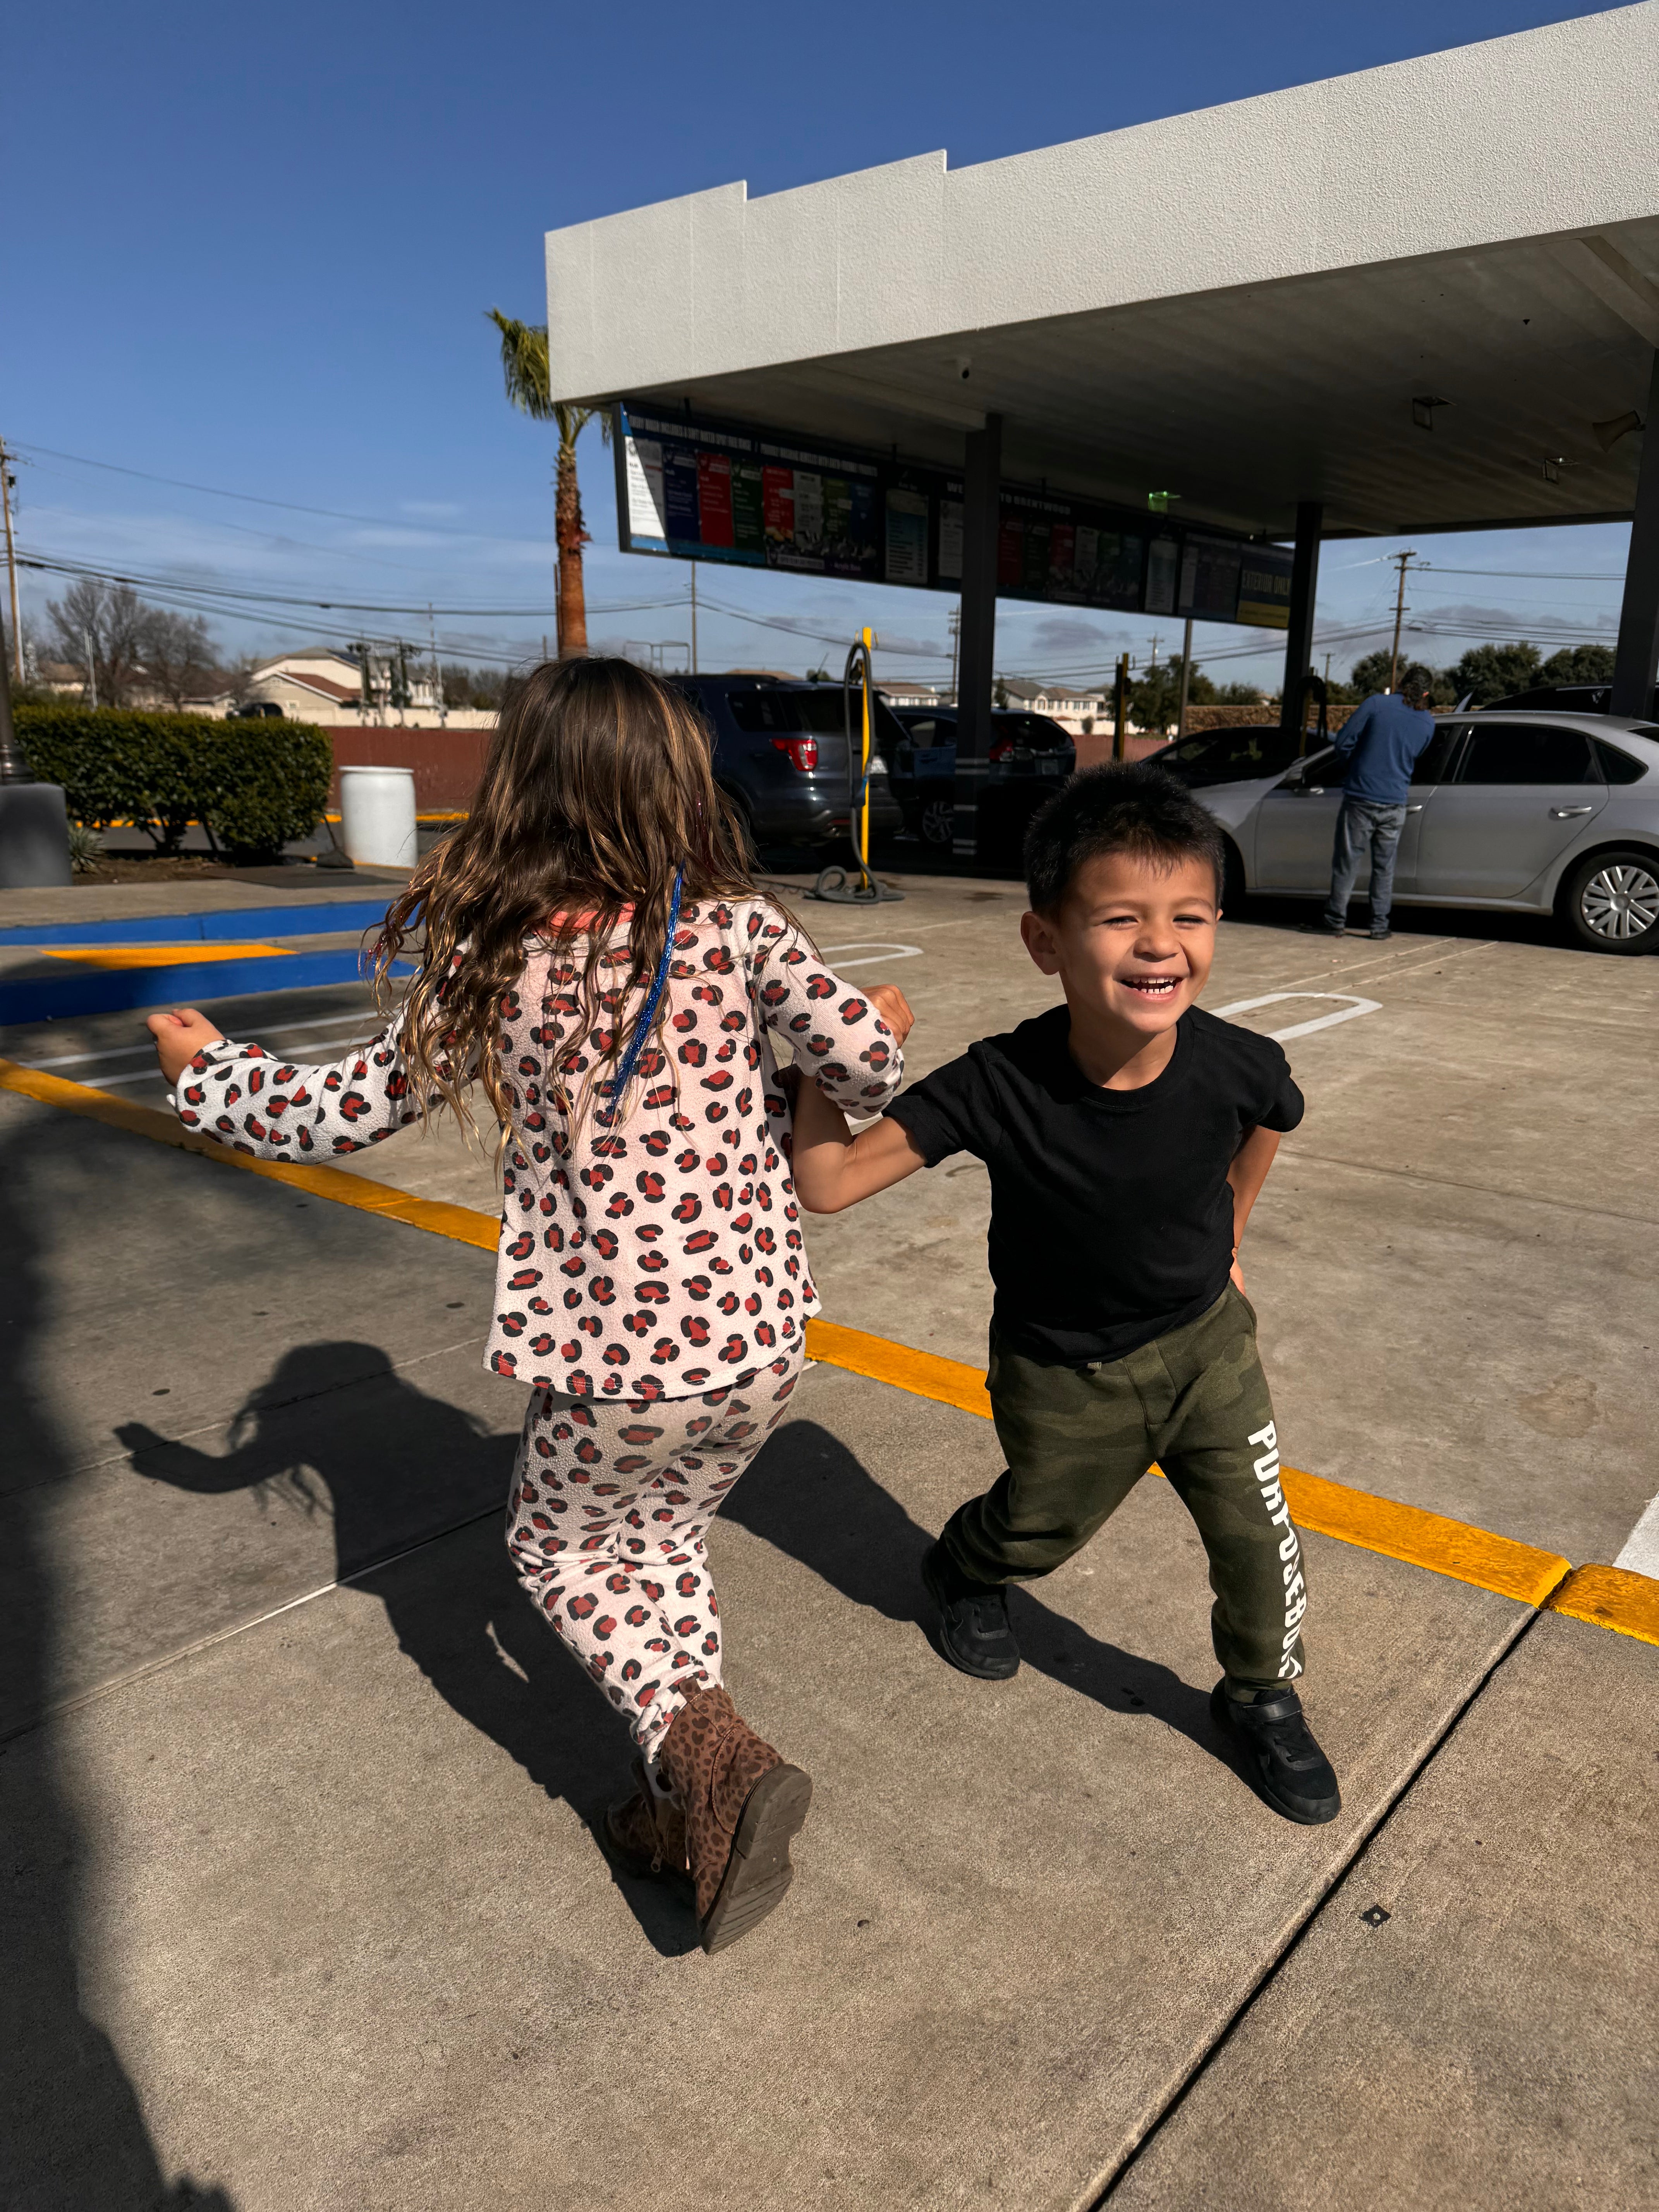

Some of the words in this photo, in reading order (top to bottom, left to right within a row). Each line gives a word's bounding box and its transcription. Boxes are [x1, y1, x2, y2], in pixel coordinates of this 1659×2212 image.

[1000, 493, 1013, 504] TO
[1013, 496, 1072, 515] BRENTWOOD
[1242, 570, 1273, 594] EXTERIOR
